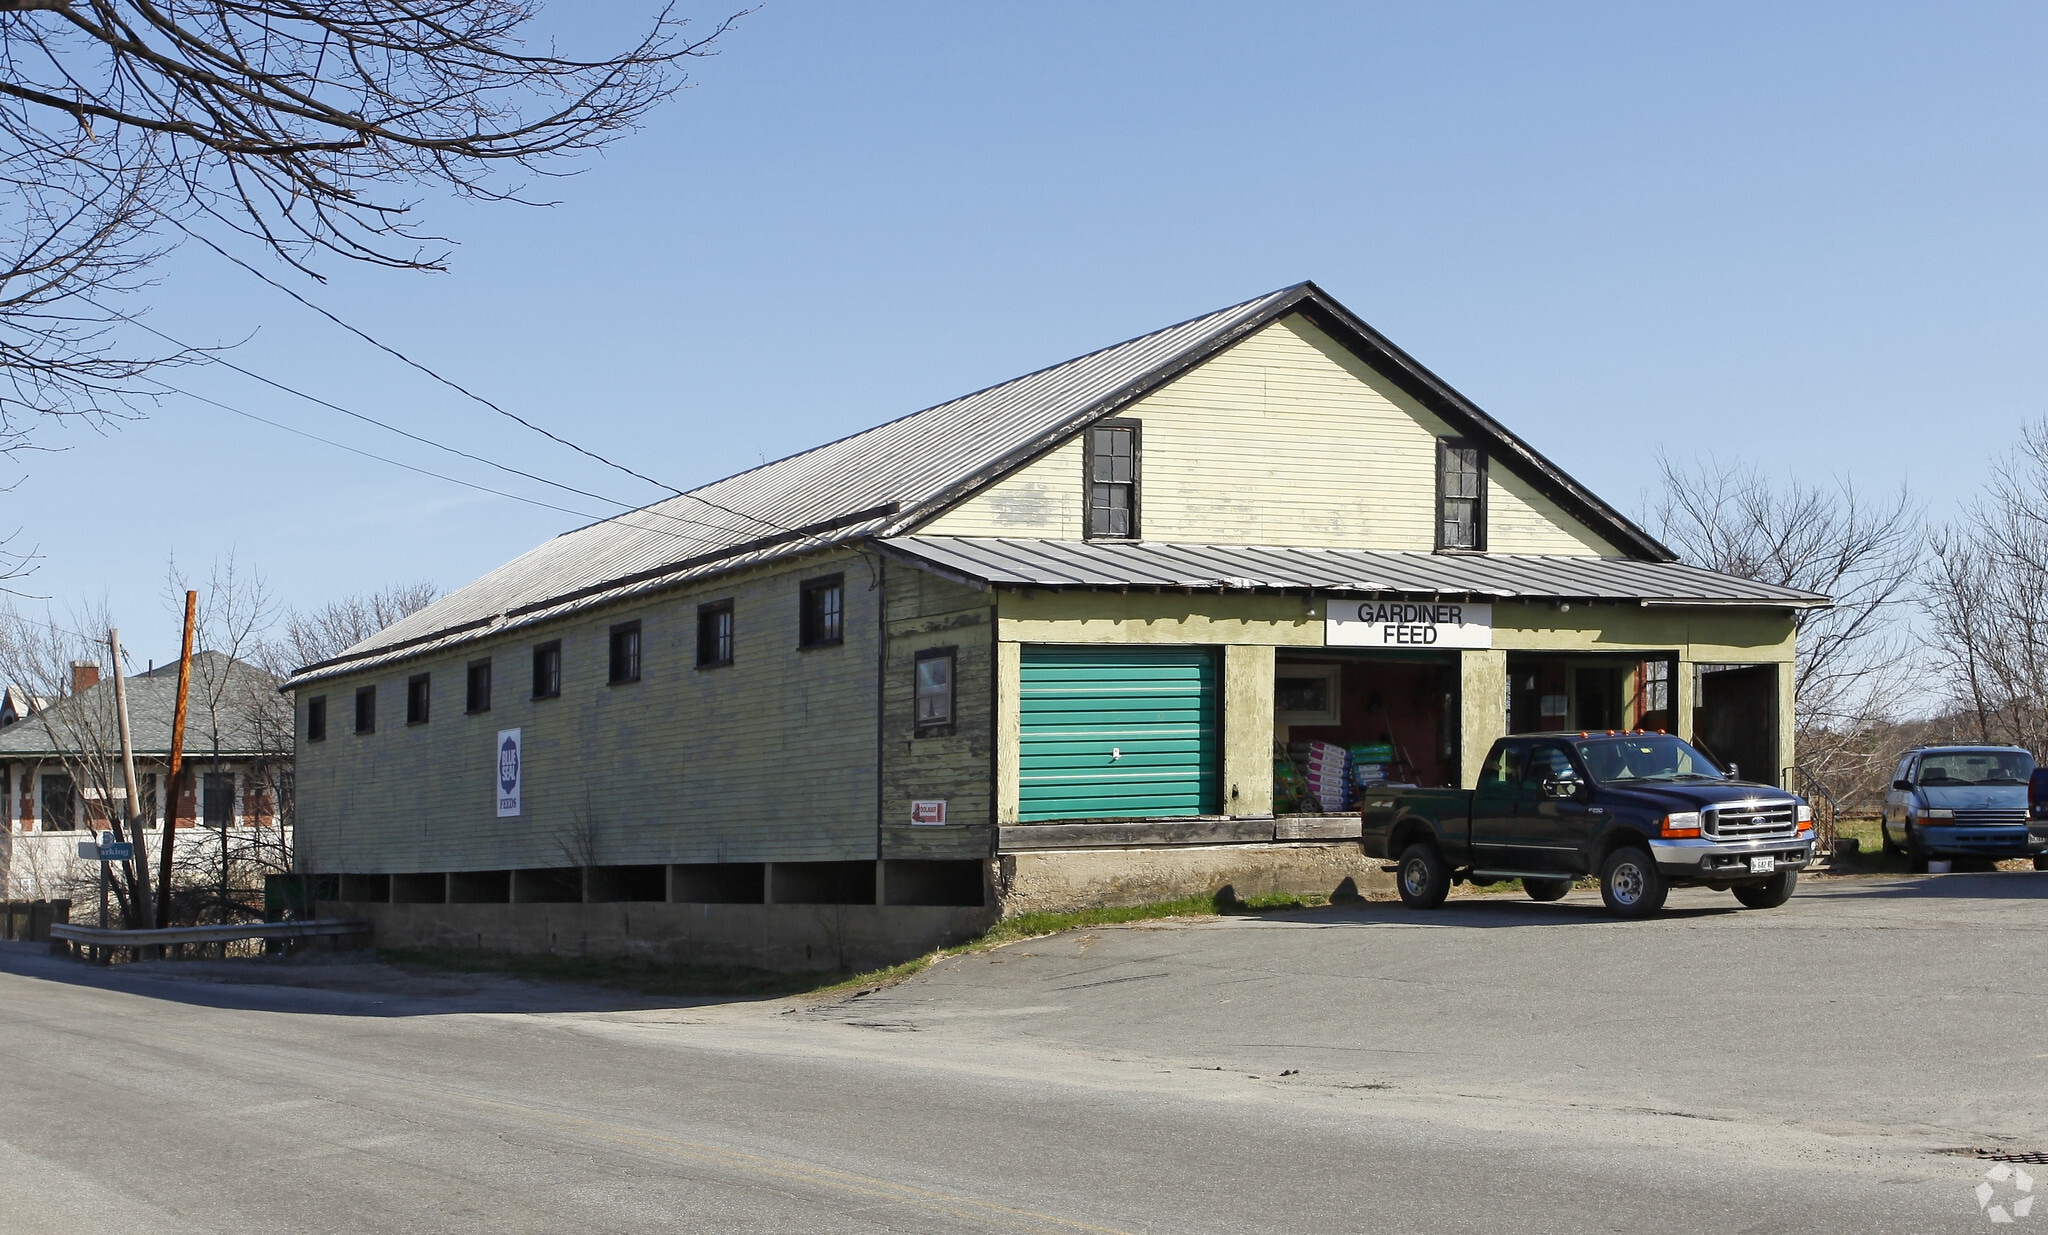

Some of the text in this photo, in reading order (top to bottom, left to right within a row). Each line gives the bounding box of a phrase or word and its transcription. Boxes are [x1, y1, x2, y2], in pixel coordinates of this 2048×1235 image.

[1357, 603, 1462, 624] GARDINER
[1383, 625, 1438, 645] FEED
[502, 750, 516, 765] BLUE
[502, 765, 516, 781] SEAL
[500, 798, 517, 809] FEEDS
[100, 847, 129, 857] arking
